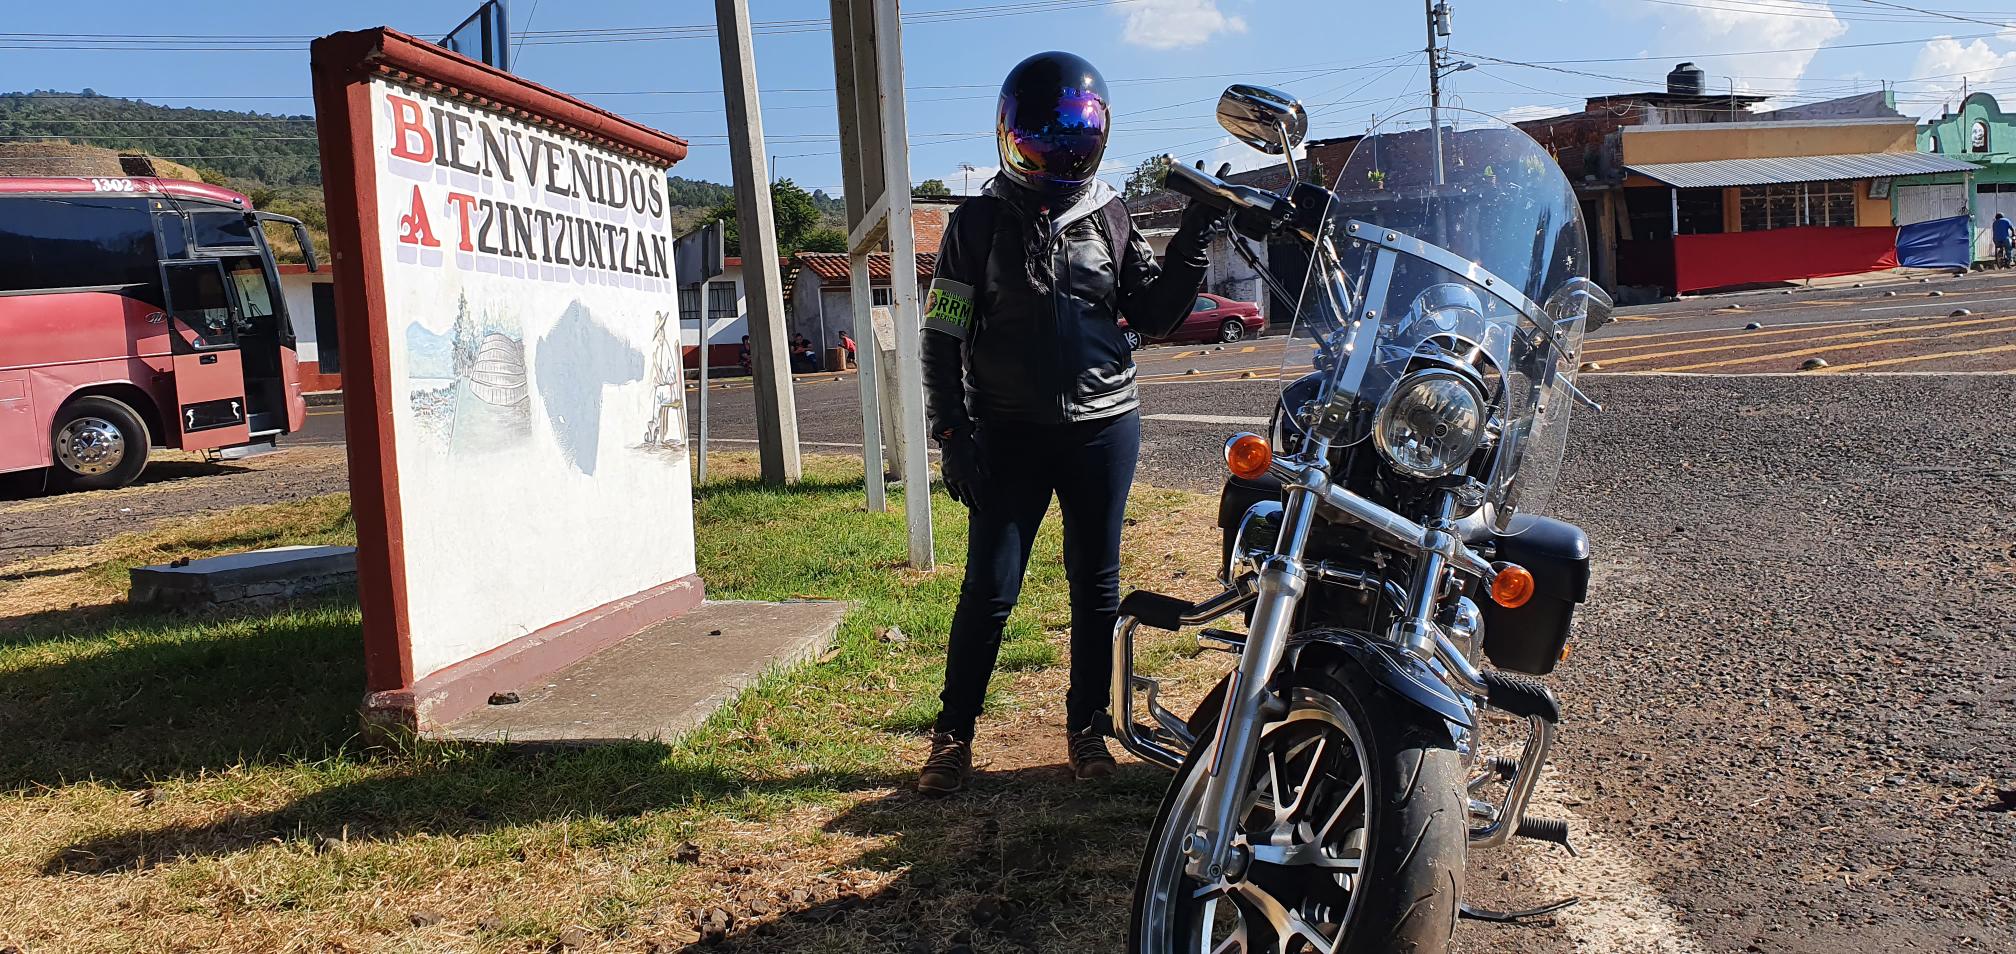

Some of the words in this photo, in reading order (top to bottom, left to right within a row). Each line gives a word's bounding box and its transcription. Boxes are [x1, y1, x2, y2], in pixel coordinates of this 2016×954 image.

[92, 179, 134, 192] 1302
[386, 94, 663, 218] BIENVENIDOS
[400, 184, 441, 248] A
[447, 192, 670, 279] TZINTZUNTZAN
[937, 296, 971, 320] RRM
